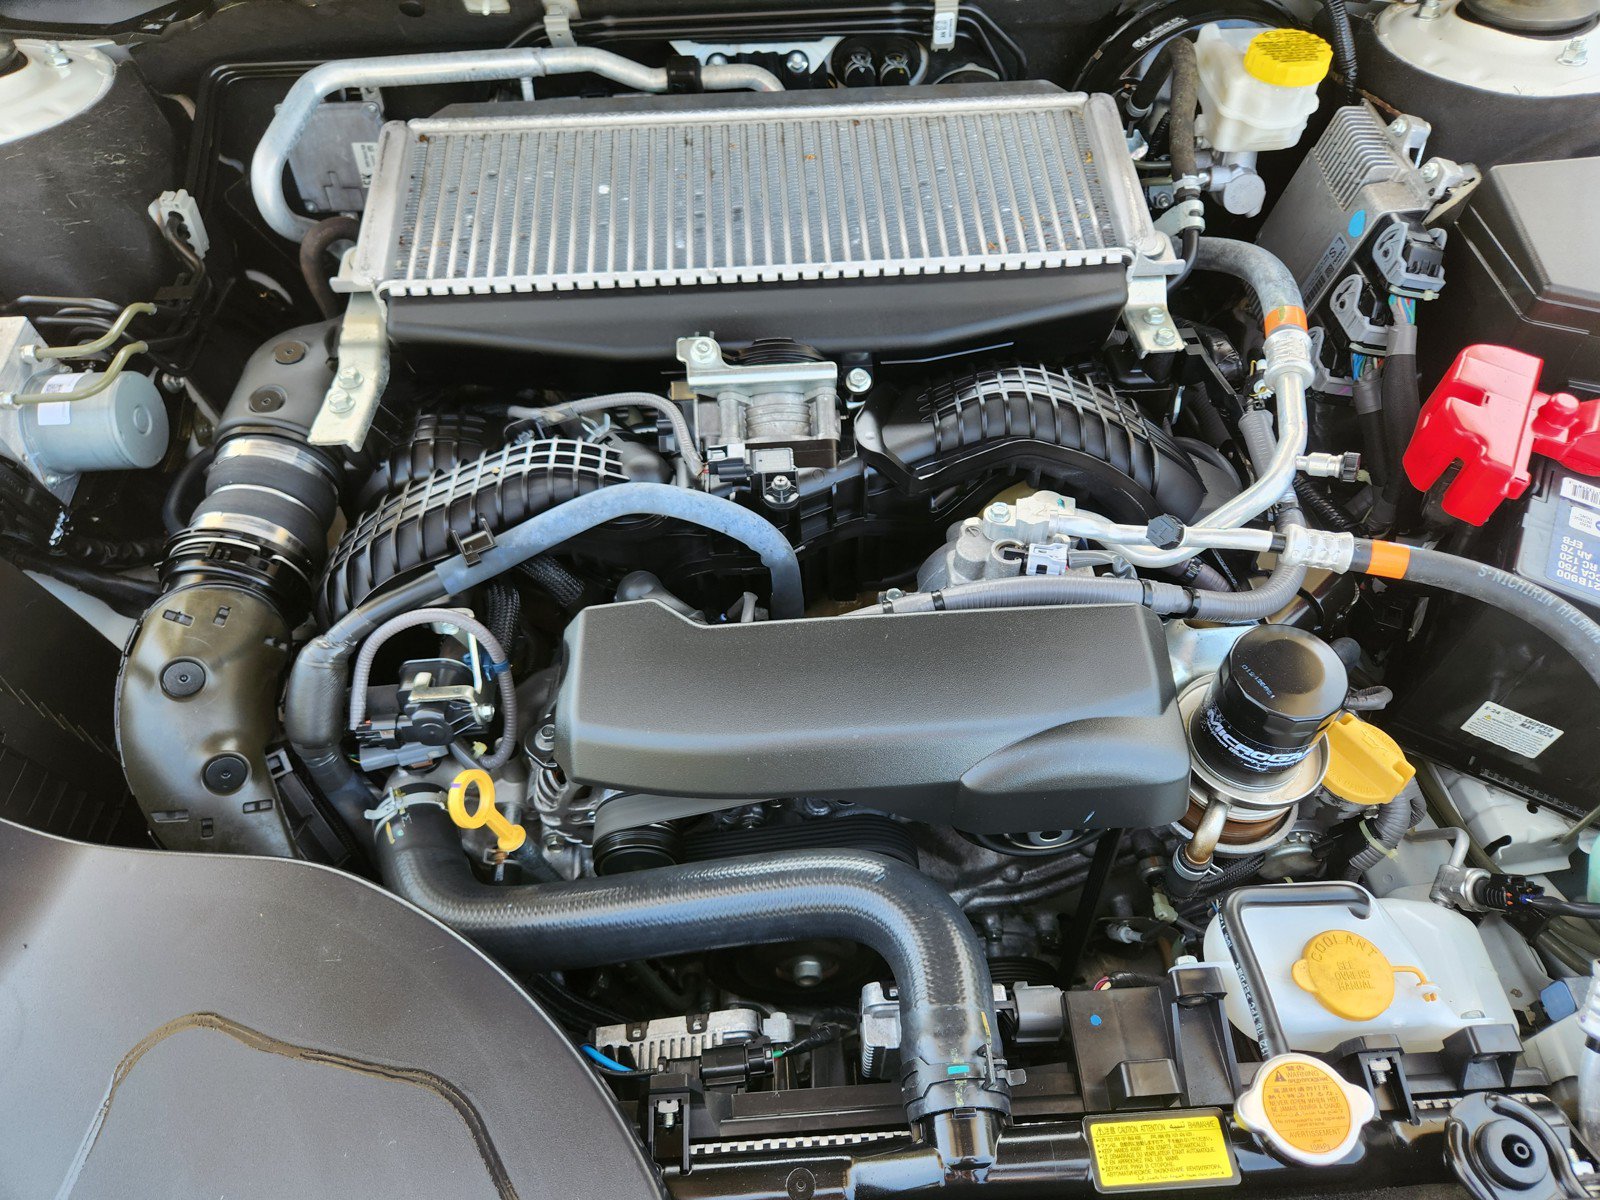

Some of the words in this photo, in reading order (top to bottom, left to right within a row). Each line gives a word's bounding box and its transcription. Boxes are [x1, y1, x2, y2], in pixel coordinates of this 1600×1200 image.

[1562, 536, 1584, 549] EFB
[1559, 552, 1579, 564] 120
[1558, 560, 1578, 574] 750
[1582, 560, 1598, 572] RC
[1311, 934, 1378, 962] COOLANT
[1117, 1125, 1139, 1134] CAUTION
[1140, 1123, 1166, 1132] ATTENTION
[1290, 1128, 1341, 1138] AVERTISSEMENT
